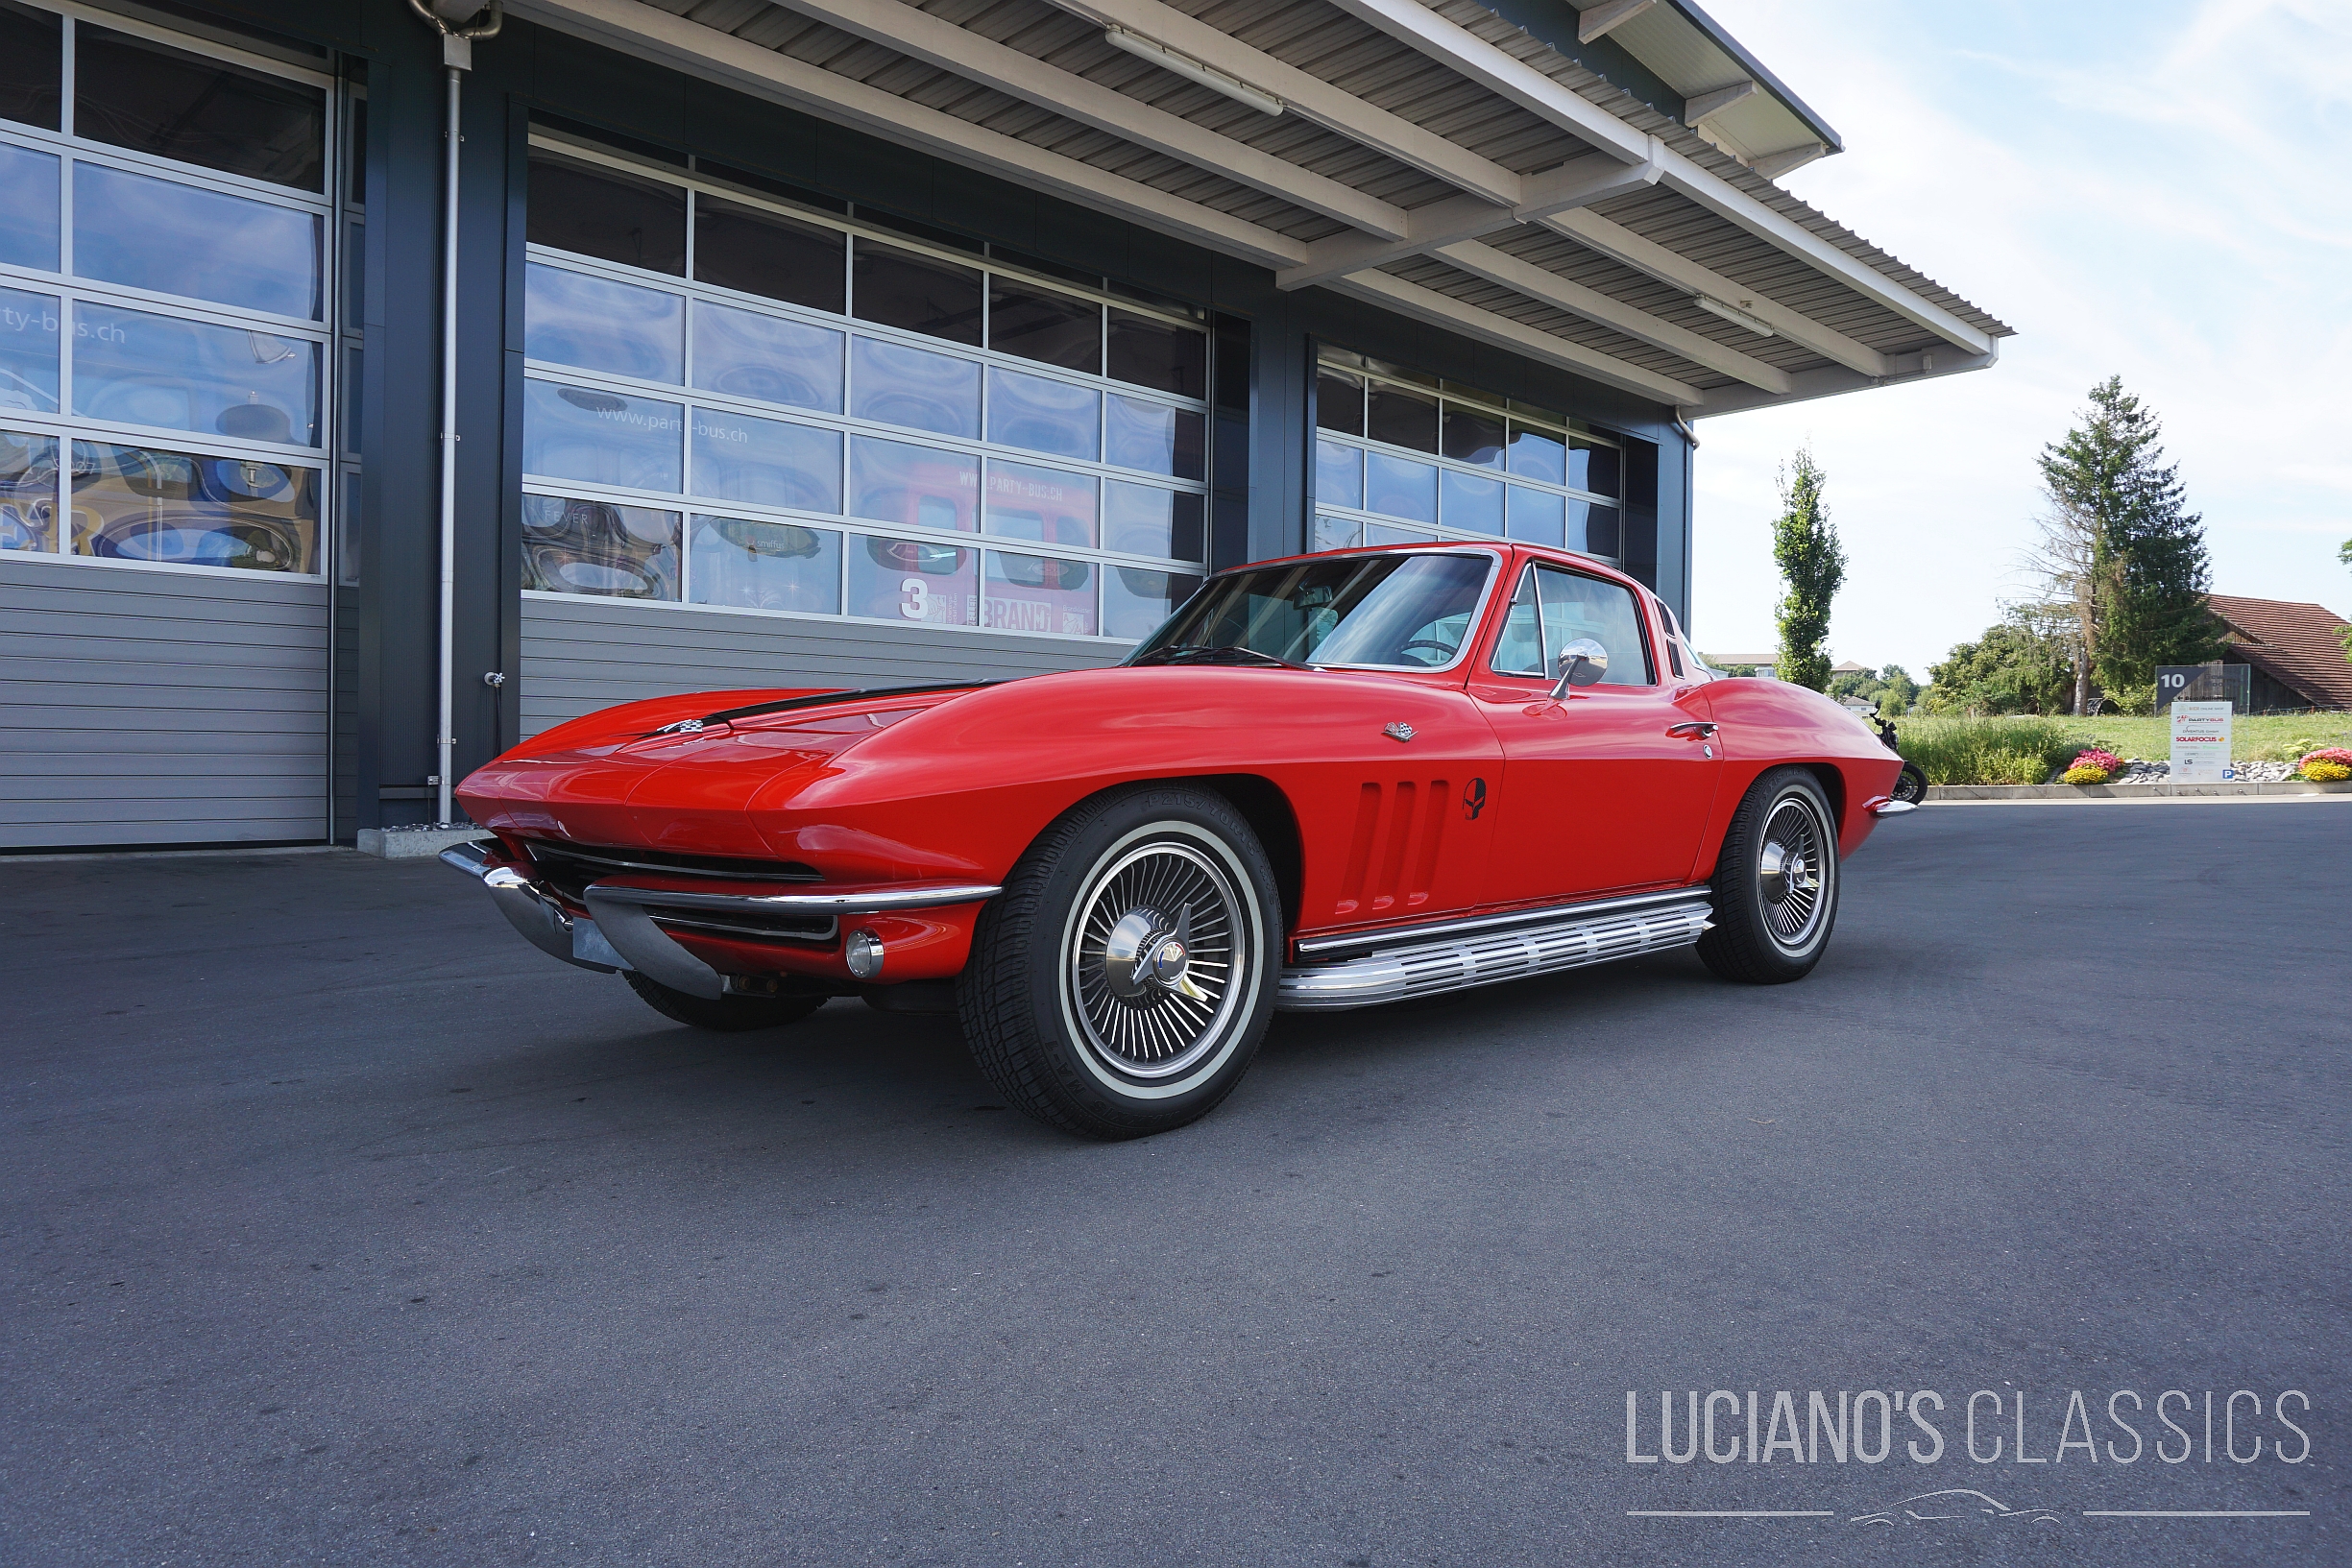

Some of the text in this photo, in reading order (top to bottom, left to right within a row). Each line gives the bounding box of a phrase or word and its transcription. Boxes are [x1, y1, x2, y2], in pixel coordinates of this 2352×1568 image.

[0, 306, 126, 344] ty-bs.ch
[595, 406, 748, 444] www.part-bus.ch
[958, 470, 1063, 501] WW.PARTY-BUS.CH
[545, 509, 589, 524] FEVER
[757, 540, 785, 551] smiffys
[900, 578, 928, 619] 3
[2160, 673, 2186, 688] 10
